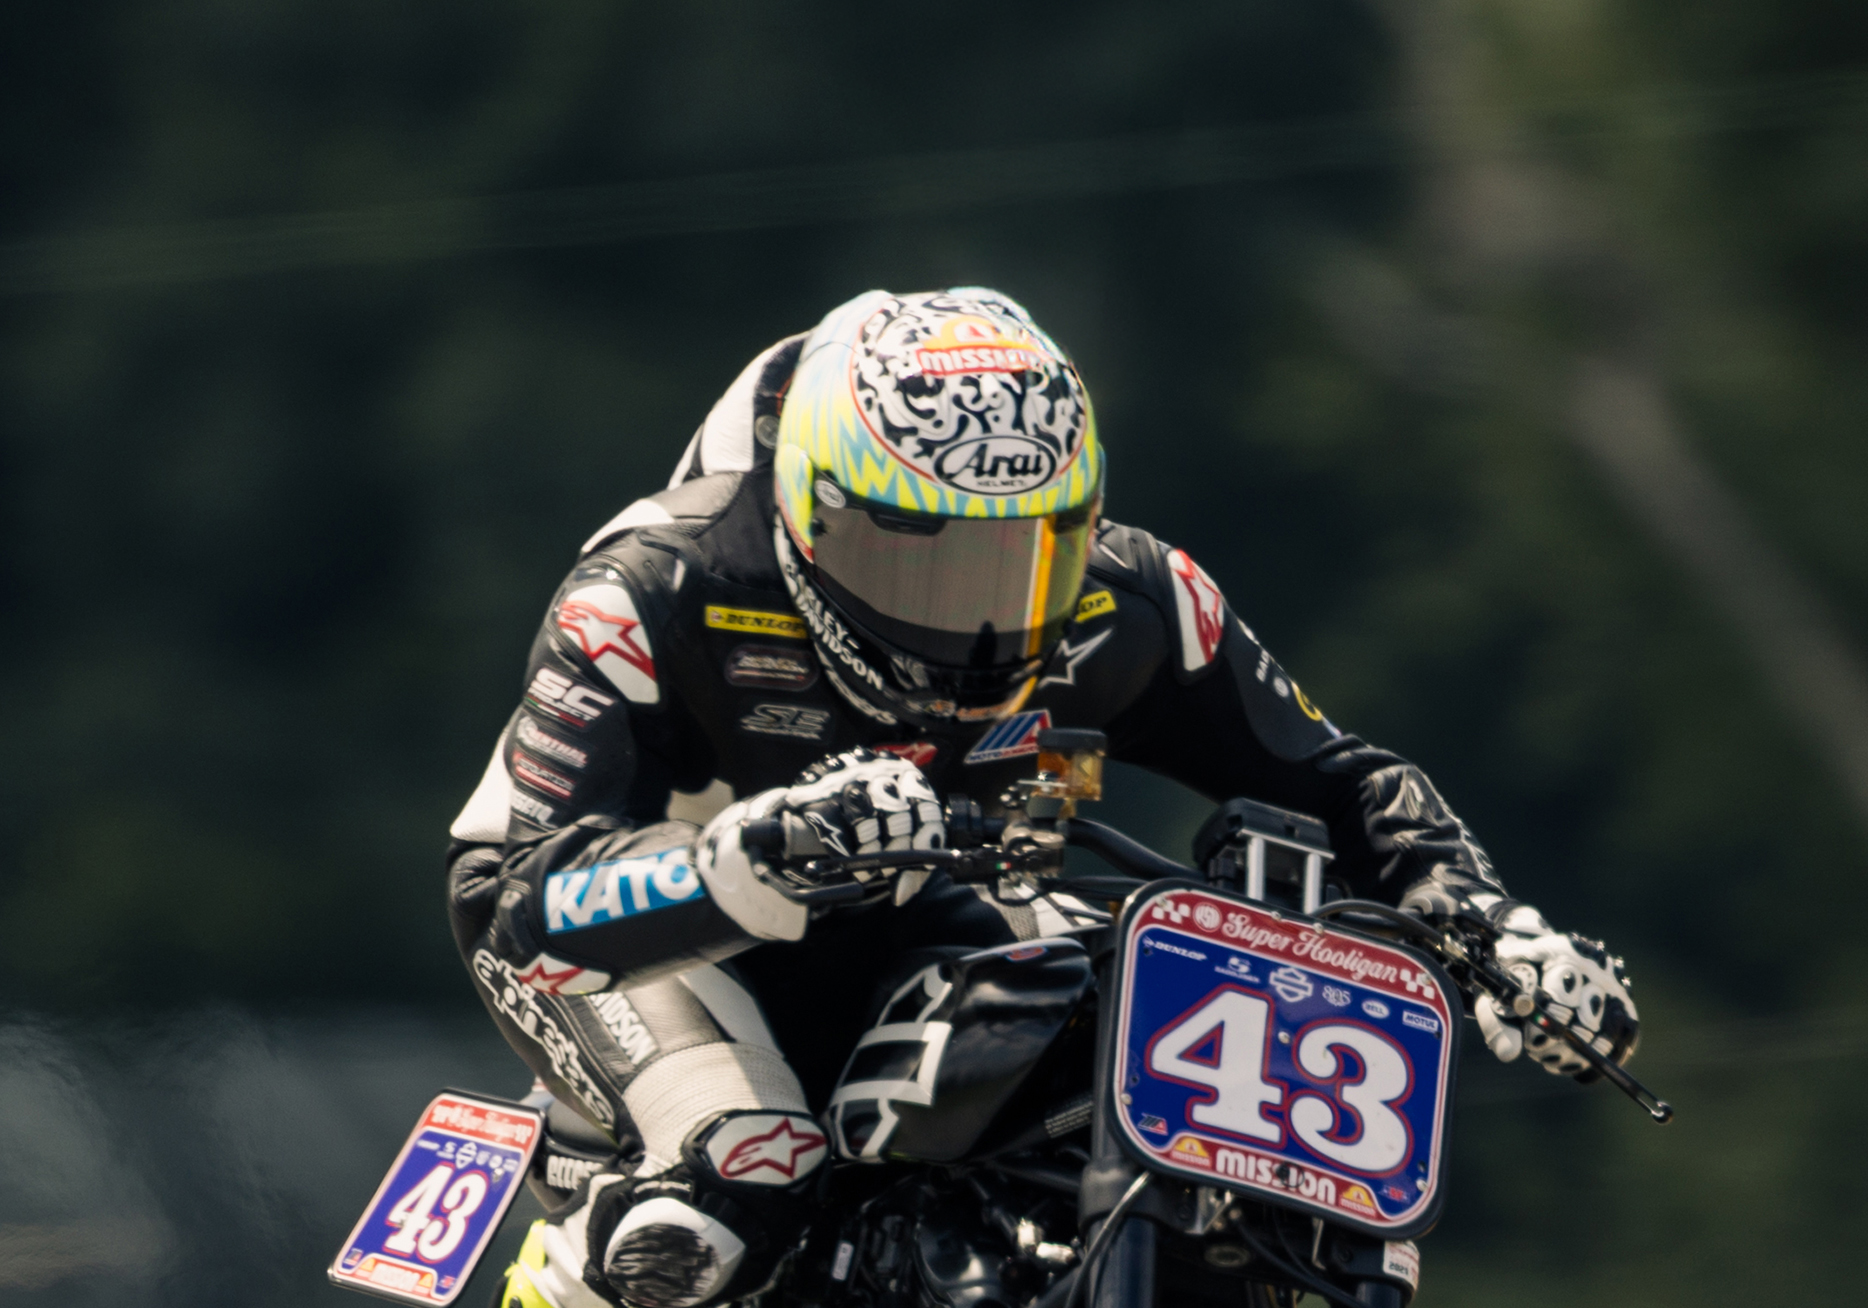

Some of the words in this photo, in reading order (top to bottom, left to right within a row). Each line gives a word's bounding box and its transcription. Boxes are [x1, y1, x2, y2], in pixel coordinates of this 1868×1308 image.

[944, 443, 1043, 479] Arai
[530, 666, 615, 718] SC
[545, 847, 701, 930] KATO
[1222, 911, 1295, 952] Super
[1292, 930, 1398, 984] Hooligan
[1405, 1013, 1436, 1029] MOTUL
[1149, 987, 1411, 1175] 43
[386, 1163, 488, 1262] 43
